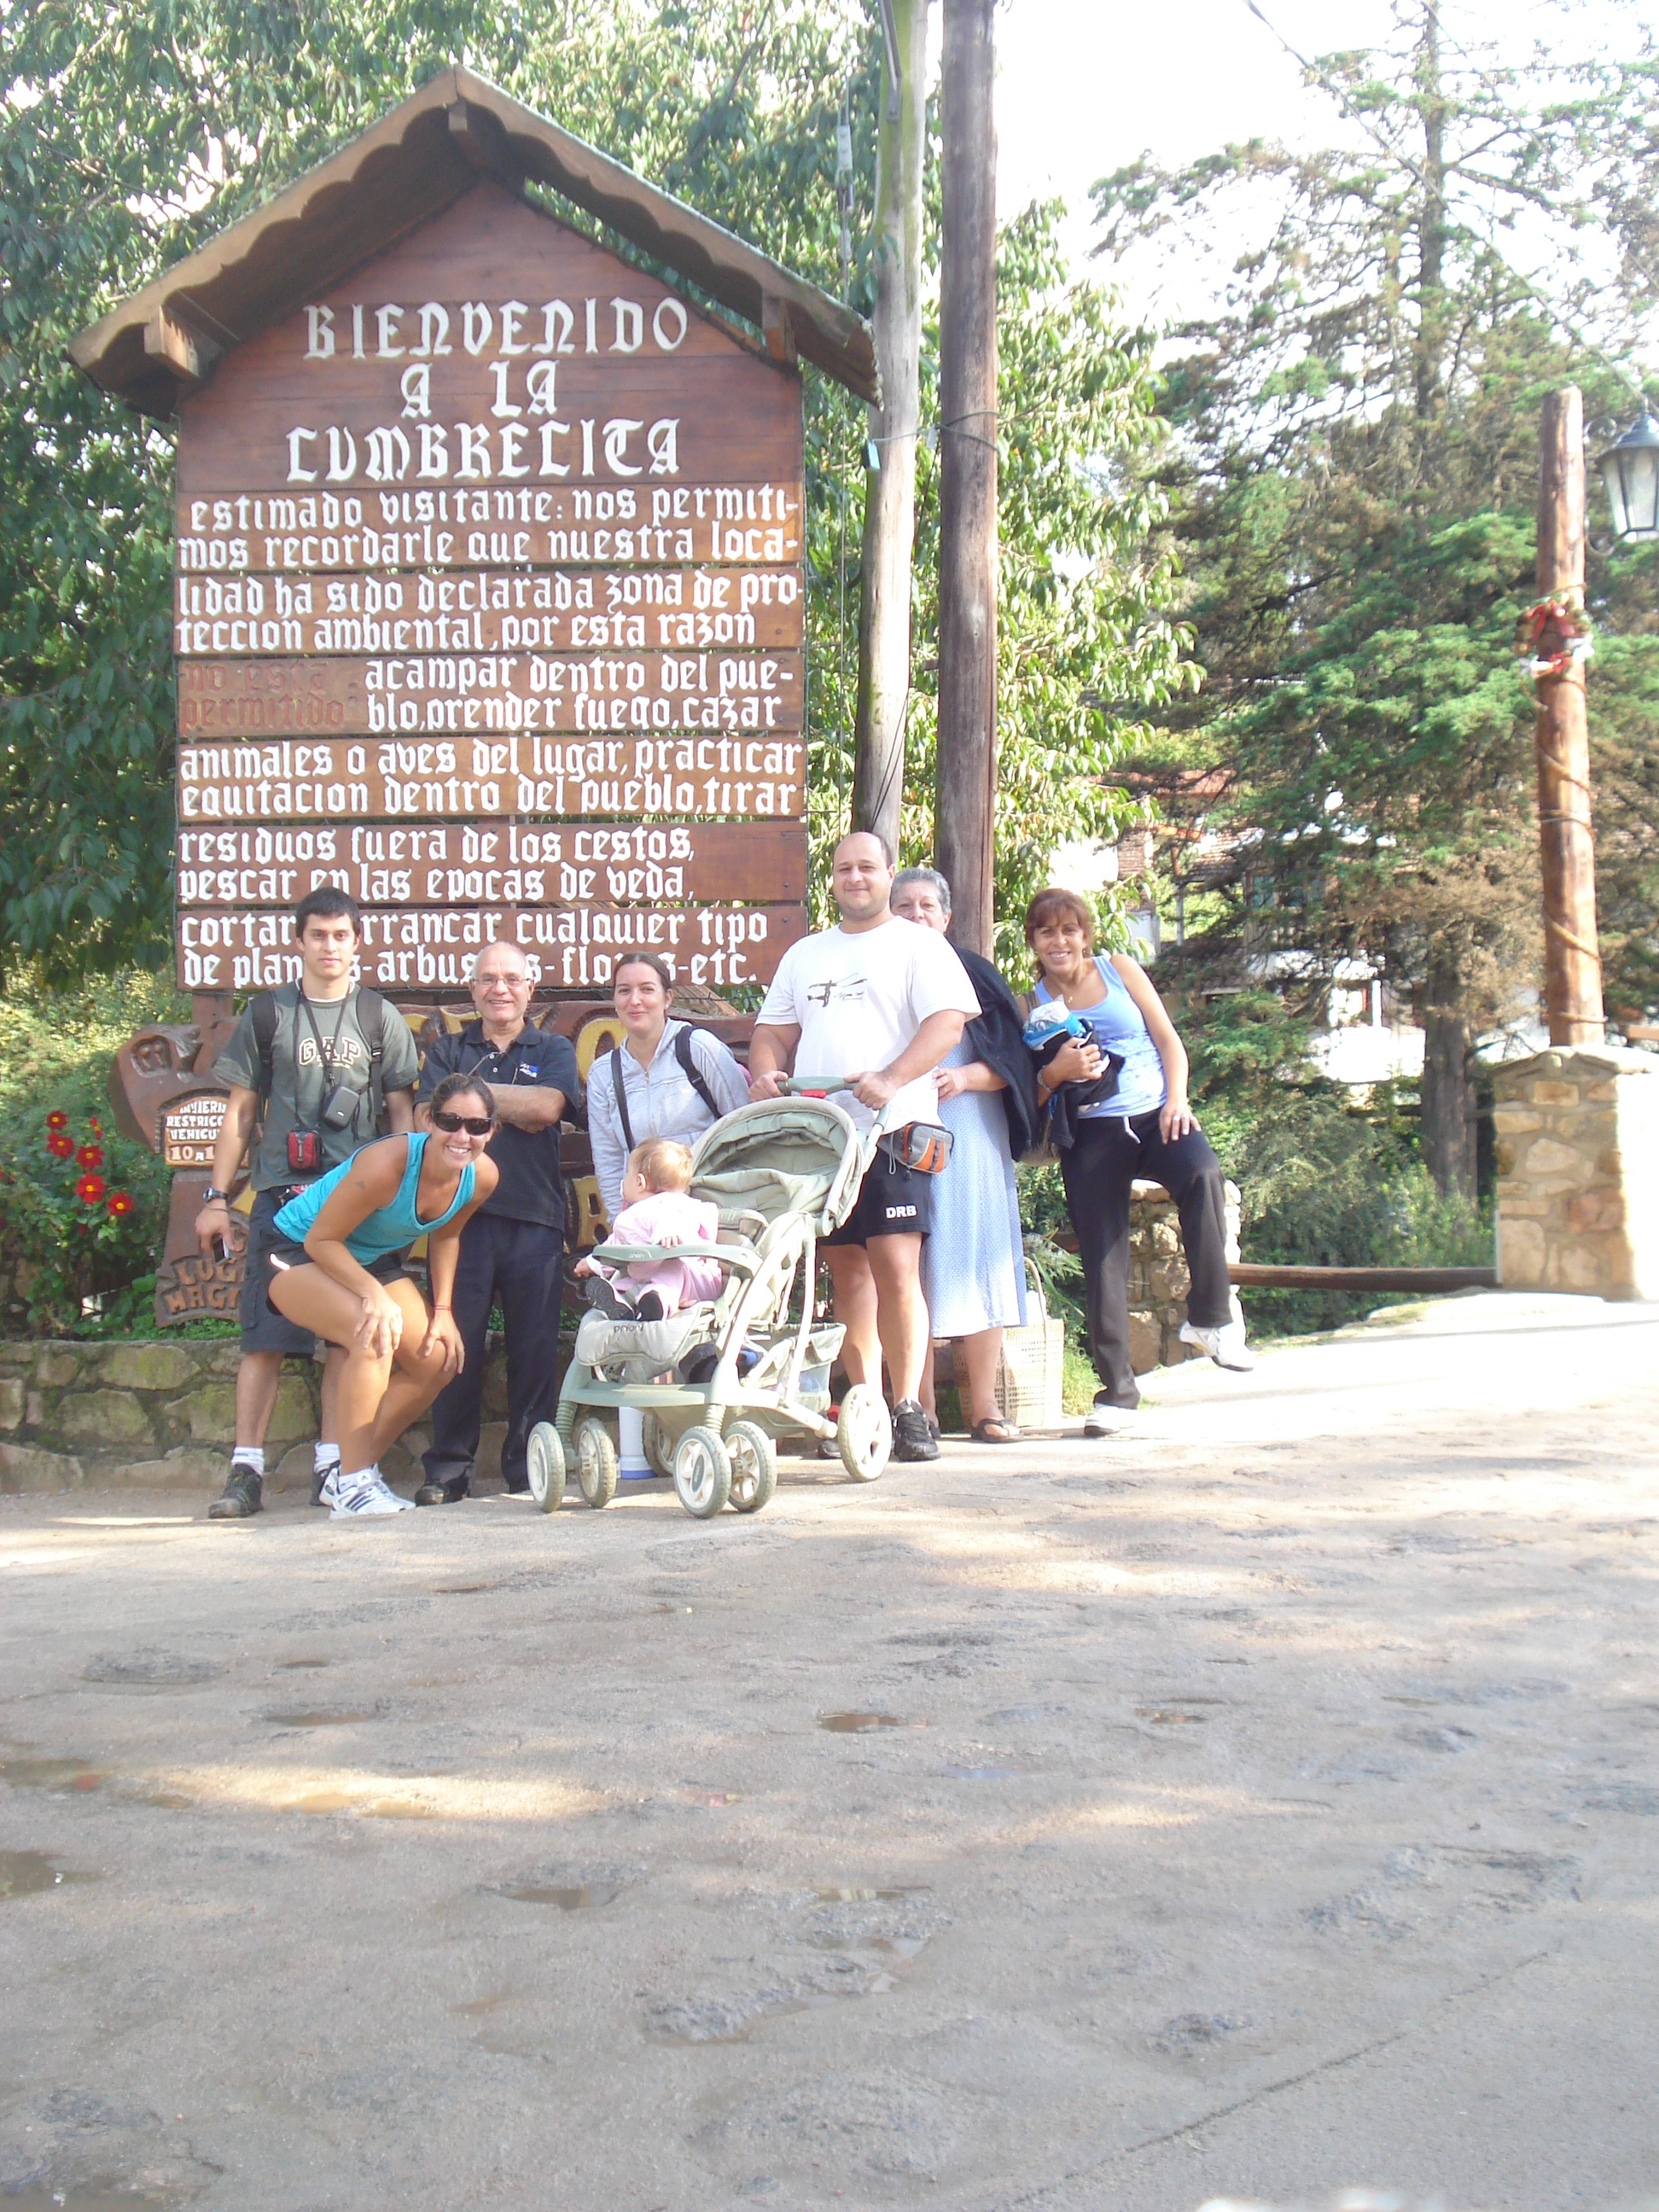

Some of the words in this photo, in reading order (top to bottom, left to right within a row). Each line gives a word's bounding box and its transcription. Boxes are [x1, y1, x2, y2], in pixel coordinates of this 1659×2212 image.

[304, 296, 688, 360] BIENVENIDO
[400, 363, 433, 418] A
[488, 360, 559, 417] LA
[286, 418, 680, 482] CUMBRECITA
[190, 491, 362, 532] estimado
[380, 487, 562, 524] visitante:
[572, 488, 637, 521] nos
[652, 482, 800, 527] permiti-
[178, 537, 248, 569] mos
[265, 525, 454, 568] recordarle
[469, 531, 531, 563] que
[547, 524, 694, 560] nuestra
[712, 521, 799, 561] loca-
[178, 576, 264, 617] lidad
[275, 576, 312, 620] ha
[327, 575, 404, 614] sido
[418, 573, 594, 613] declarada
[605, 573, 682, 614] zona
[693, 570, 731, 609] de
[175, 617, 302, 654] teccion
[571, 611, 646, 647] esta
[657, 612, 756, 648] razon
[365, 656, 518, 696] acampar
[529, 655, 645, 694] dentro
[661, 654, 708, 693] del
[719, 658, 794, 698] pue-
[179, 741, 333, 782] animales
[347, 744, 366, 776] o
[377, 742, 457, 776] aves
[472, 737, 520, 777] del
[182, 779, 368, 818] equitacion
[384, 775, 500, 815] dentro
[517, 773, 565, 815] del
[178, 827, 336, 864] residuos
[351, 826, 447, 864] fuera
[462, 825, 498, 863] de
[509, 825, 562, 864] los
[573, 825, 695, 863] cestos,
[178, 868, 298, 905] pescar
[310, 868, 350, 895] en
[359, 862, 412, 902] las
[427, 868, 545, 902] epocas
[559, 861, 597, 901] de
[606, 861, 695, 901] veda,
[181, 912, 297, 948] cortar
[359, 911, 503, 946] rrancar
[516, 907, 686, 946] cualquier
[696, 907, 768, 954] tipo
[183, 946, 221, 987] de
[299, 1036, 362, 1066] GAP
[166, 1115, 224, 1126] RESTRICC
[179, 1101, 227, 1114] INVIERN
[170, 1128, 220, 1140] VEHICU
[171, 1145, 193, 1161] 10
[205, 1145, 215, 1160] 1
[886, 1204, 917, 1219] DRB
[175, 1256, 245, 1286] LUG
[163, 1284, 241, 1314] MAGI
